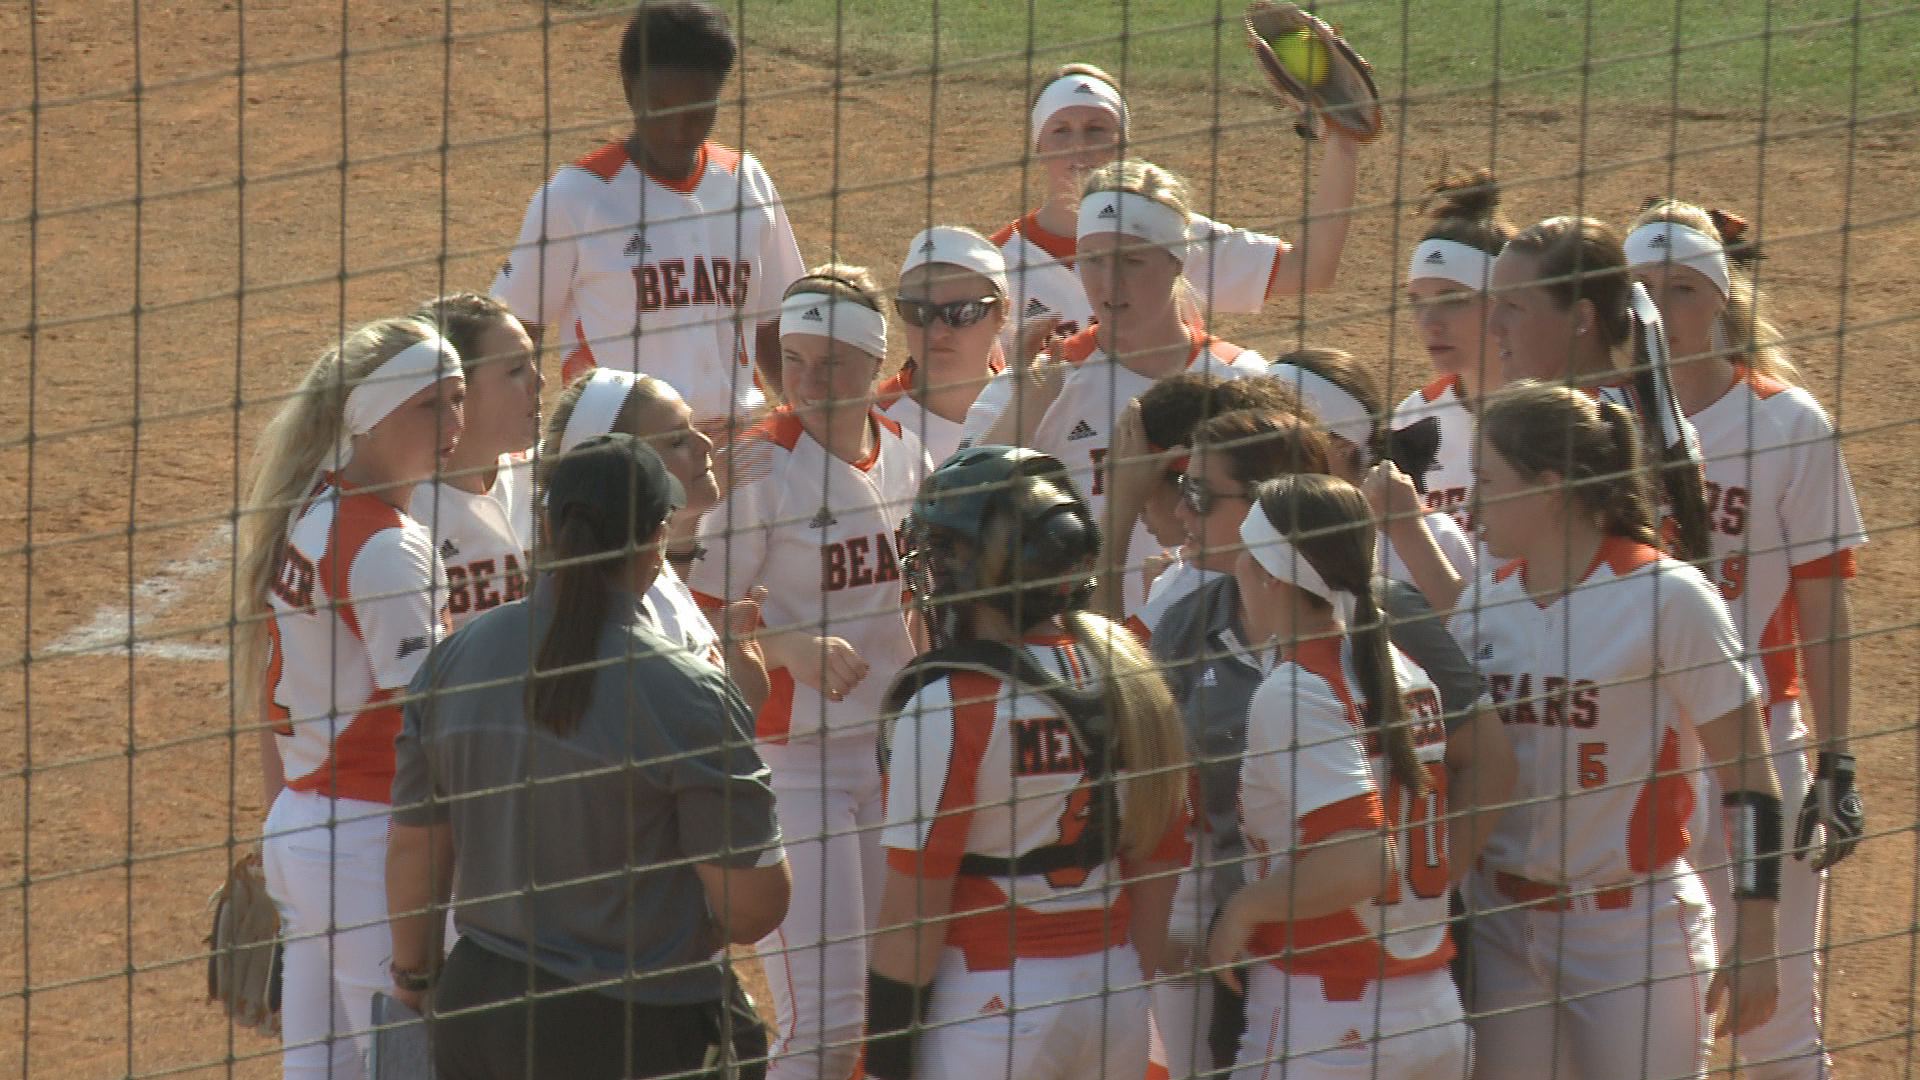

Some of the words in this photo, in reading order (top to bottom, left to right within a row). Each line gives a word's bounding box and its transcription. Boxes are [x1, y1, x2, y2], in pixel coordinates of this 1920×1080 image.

[631, 255, 751, 313] BEARS
[445, 552, 528, 614] BEA
[821, 529, 902, 592] BEA
[1489, 672, 1601, 730] EARS
[1577, 742, 1608, 790] 5
